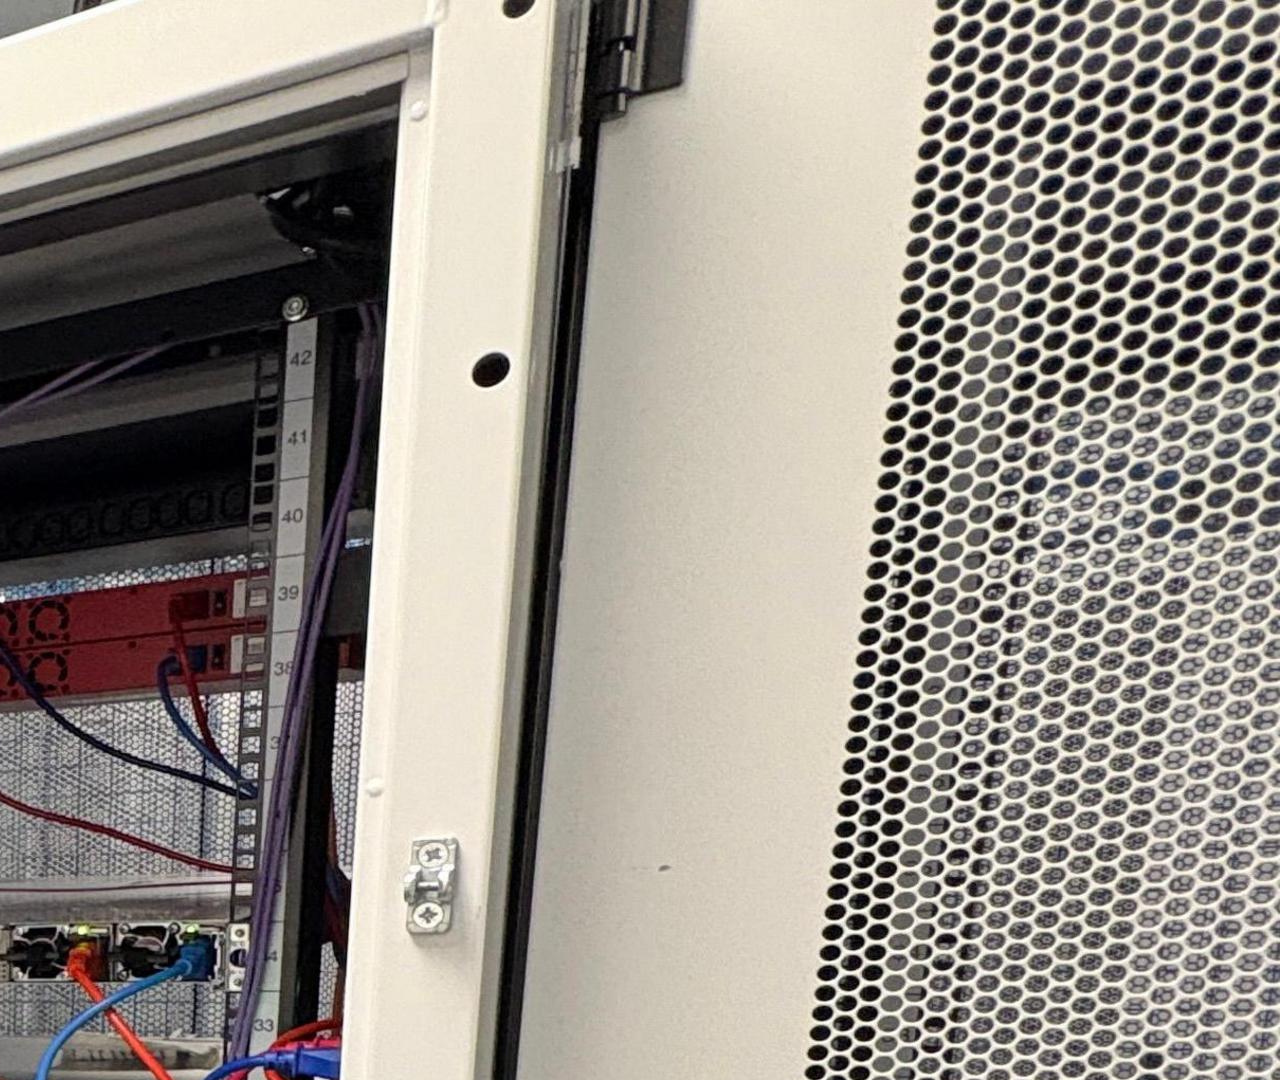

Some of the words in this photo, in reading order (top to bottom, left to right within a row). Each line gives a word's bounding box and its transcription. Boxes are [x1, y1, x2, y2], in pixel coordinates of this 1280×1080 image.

[290, 350, 312, 366] 42
[288, 430, 307, 446] 41
[281, 508, 303, 523] 40
[278, 585, 299, 601] 39
[253, 1019, 274, 1033] 33
